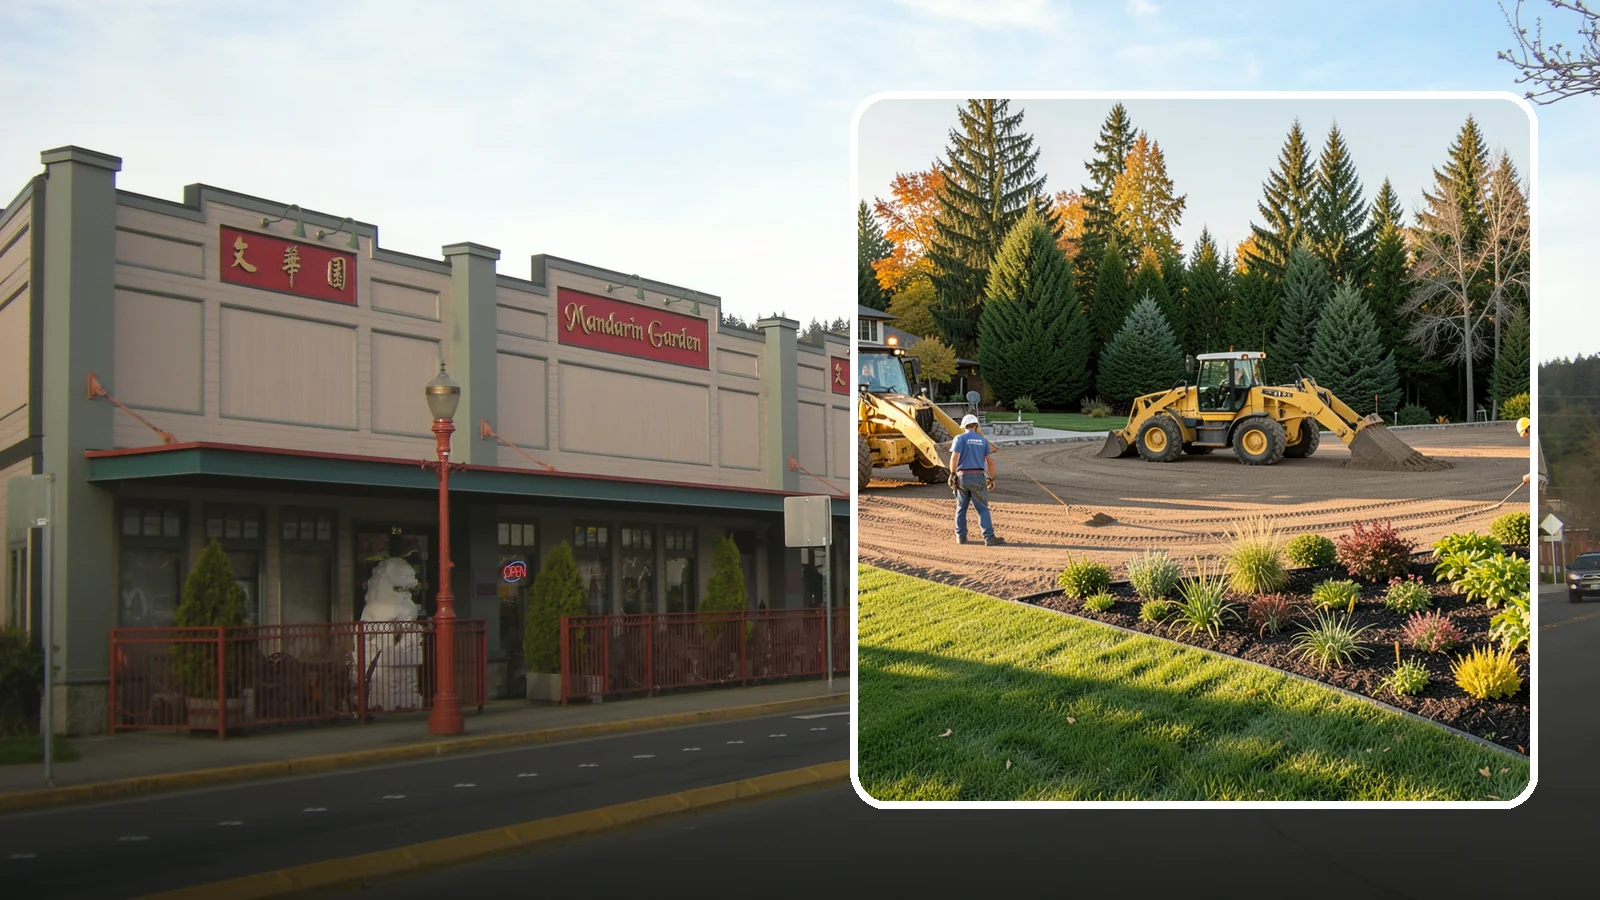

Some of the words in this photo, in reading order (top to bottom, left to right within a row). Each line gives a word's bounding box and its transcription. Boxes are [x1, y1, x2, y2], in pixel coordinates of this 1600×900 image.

[230, 235, 346, 291] 文華園
[564, 302, 644, 341] Mandarin
[647, 320, 702, 352] Garden
[503, 565, 527, 578] OPEN
